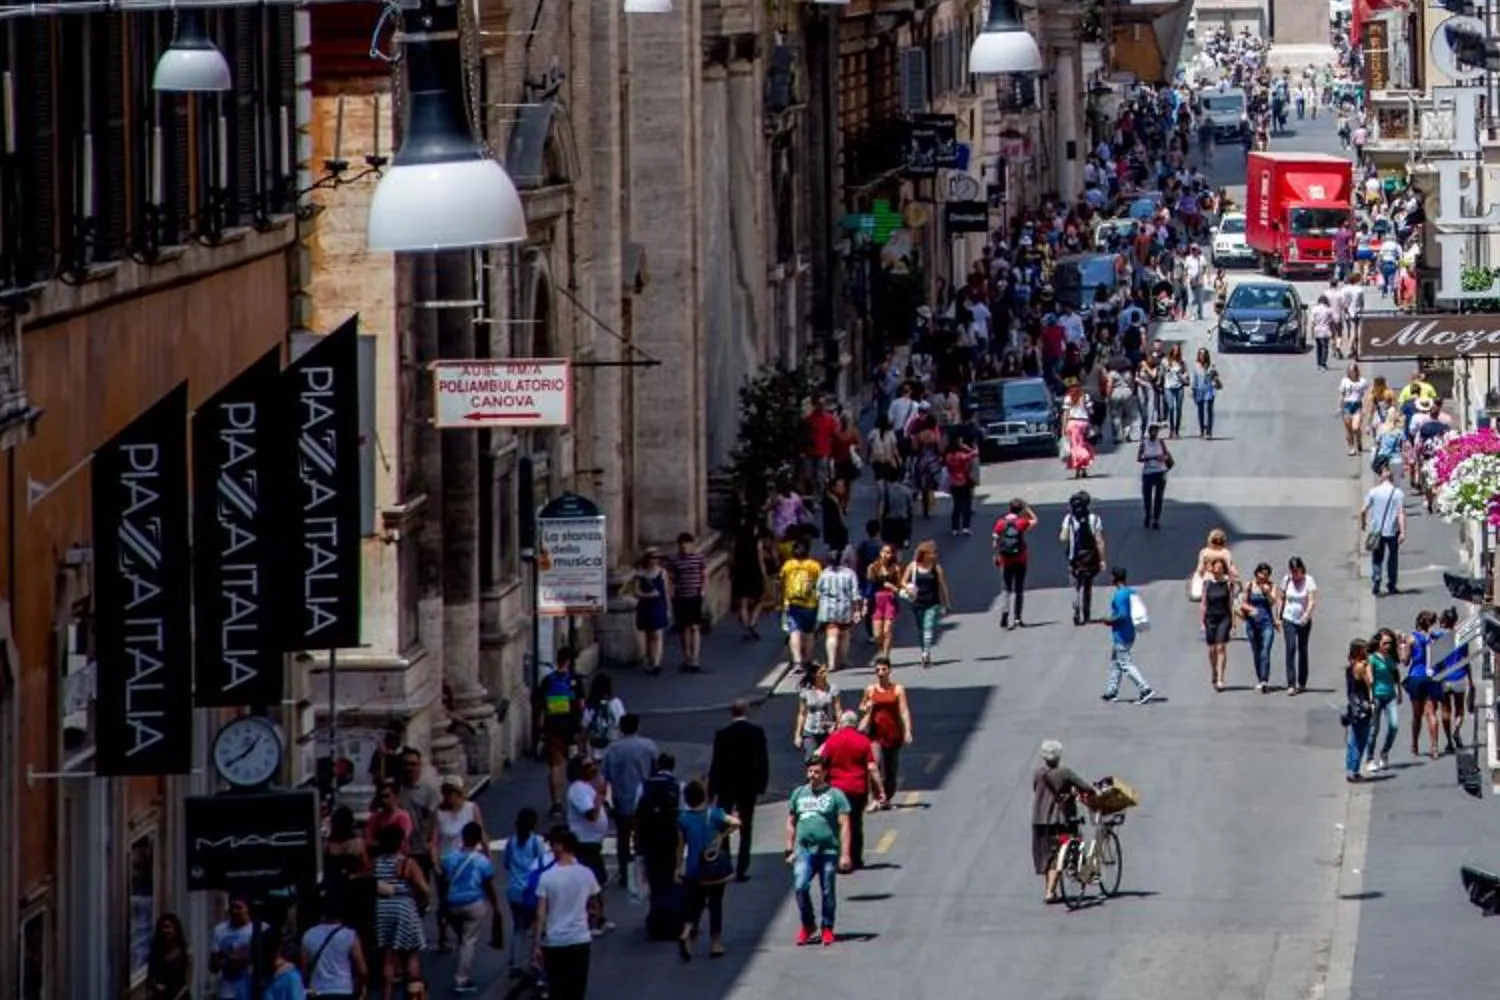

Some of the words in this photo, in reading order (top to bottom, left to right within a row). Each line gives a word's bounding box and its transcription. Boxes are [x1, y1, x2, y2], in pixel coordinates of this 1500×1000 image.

[439, 378, 564, 393] POLIAMBULATORIO
[471, 395, 535, 408] CANOVA
[545, 531, 558, 542] La
[562, 529, 603, 542] stanza
[551, 543, 581, 554] della
[553, 554, 602, 567] musica
[304, 517, 338, 636] ITALIA
[222, 564, 258, 691] ITALIA
[125, 618, 163, 757] ITALIA
